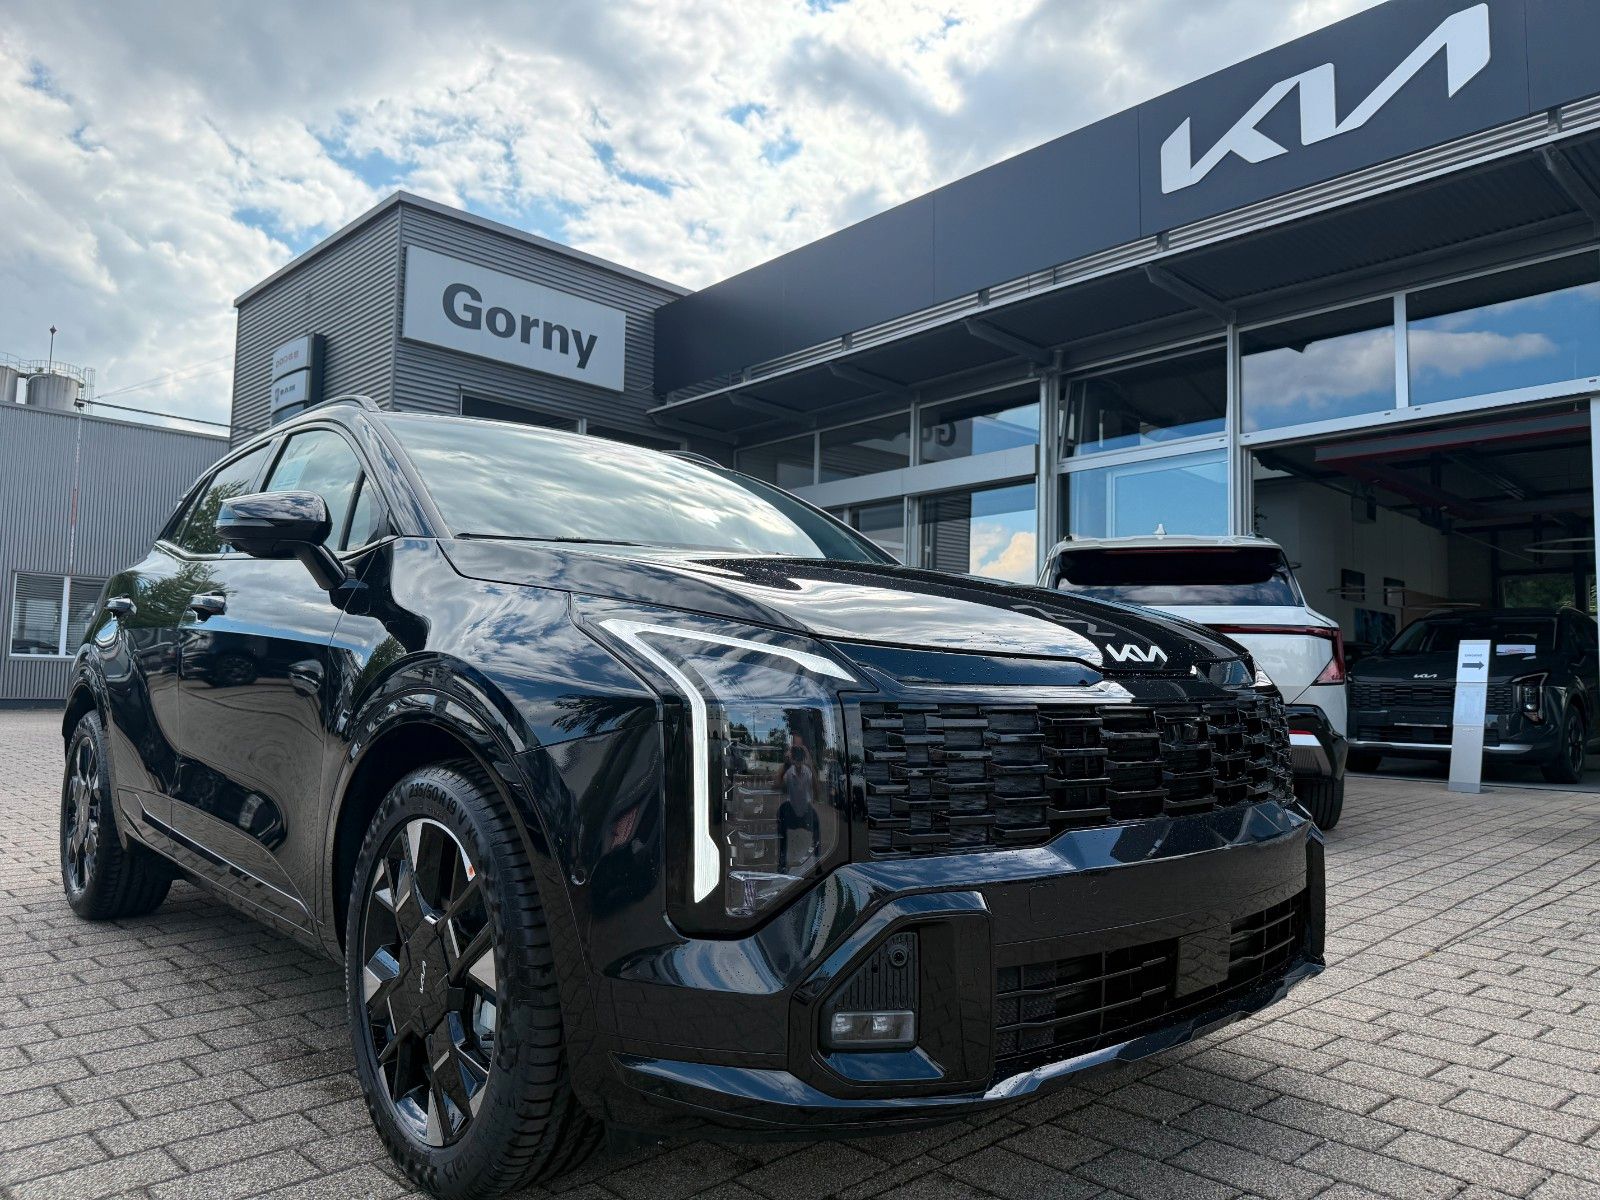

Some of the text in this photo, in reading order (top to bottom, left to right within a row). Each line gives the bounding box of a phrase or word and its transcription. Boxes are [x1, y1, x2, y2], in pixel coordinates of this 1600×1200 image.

[1160, 2, 1491, 194] KIA
[442, 282, 598, 370] Gorny
[1105, 643, 1168, 662] KIA
